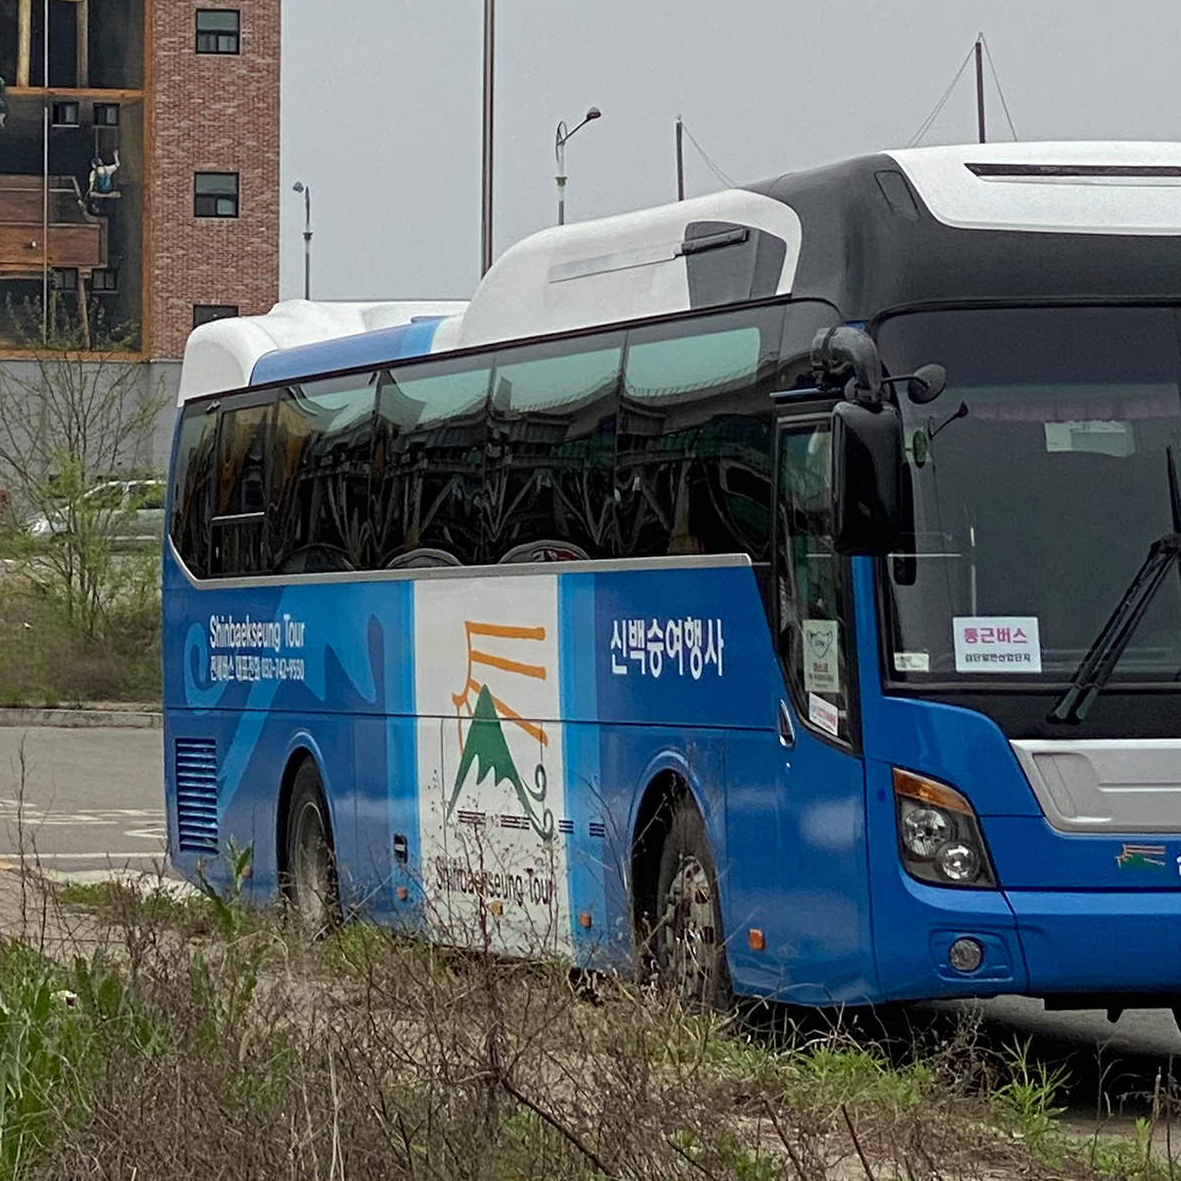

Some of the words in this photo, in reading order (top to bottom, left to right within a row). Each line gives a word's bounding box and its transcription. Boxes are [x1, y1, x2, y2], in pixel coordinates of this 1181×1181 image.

[210, 614, 281, 652] Shinbaekseung
[283, 613, 305, 648] Tour
[611, 616, 725, 680] 신백승여행사
[964, 627, 1028, 644] 통근버스
